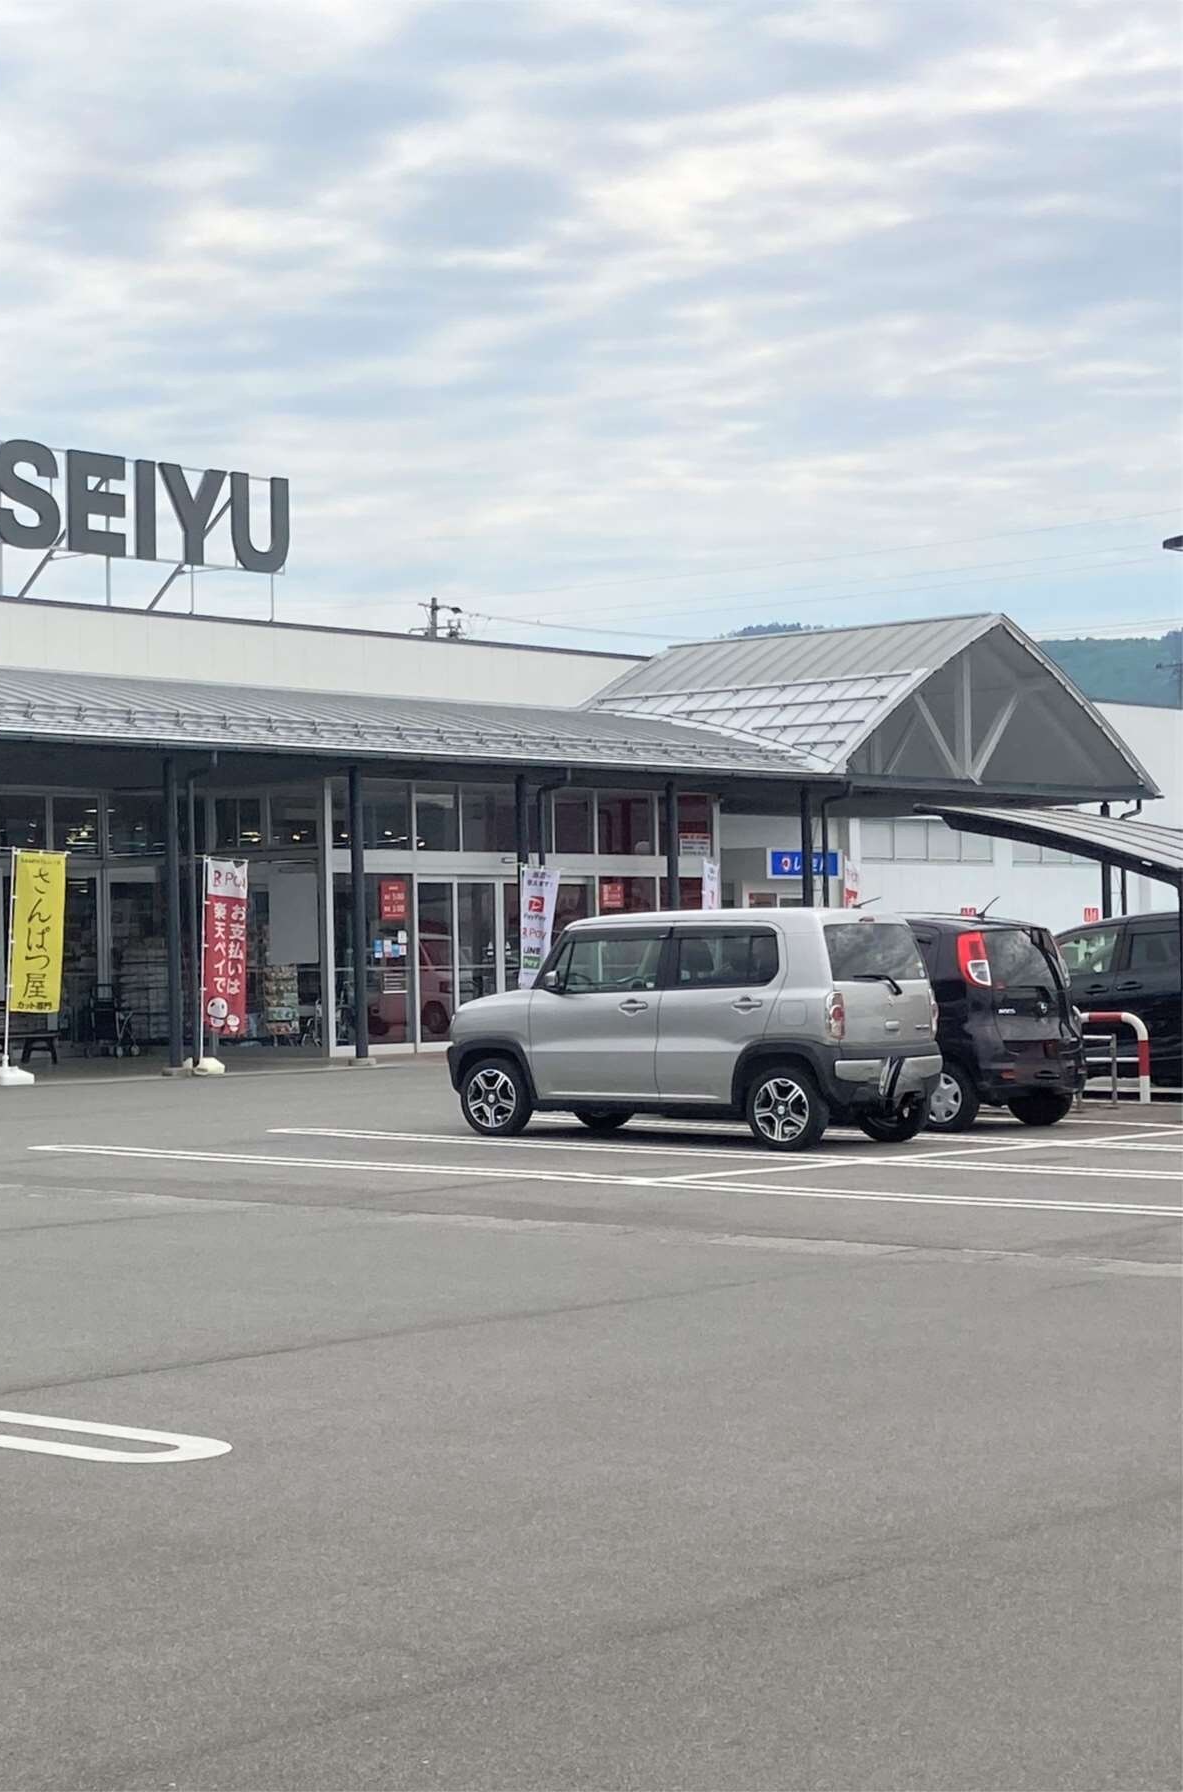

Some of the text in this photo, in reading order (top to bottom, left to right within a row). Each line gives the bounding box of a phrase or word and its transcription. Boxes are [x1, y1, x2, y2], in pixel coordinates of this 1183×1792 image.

[23, 867, 52, 999] さんぱつ屋
[213, 902, 228, 993] 楽天ペイで
[226, 904, 247, 995] お支払いは
[523, 946, 541, 955] LINE
